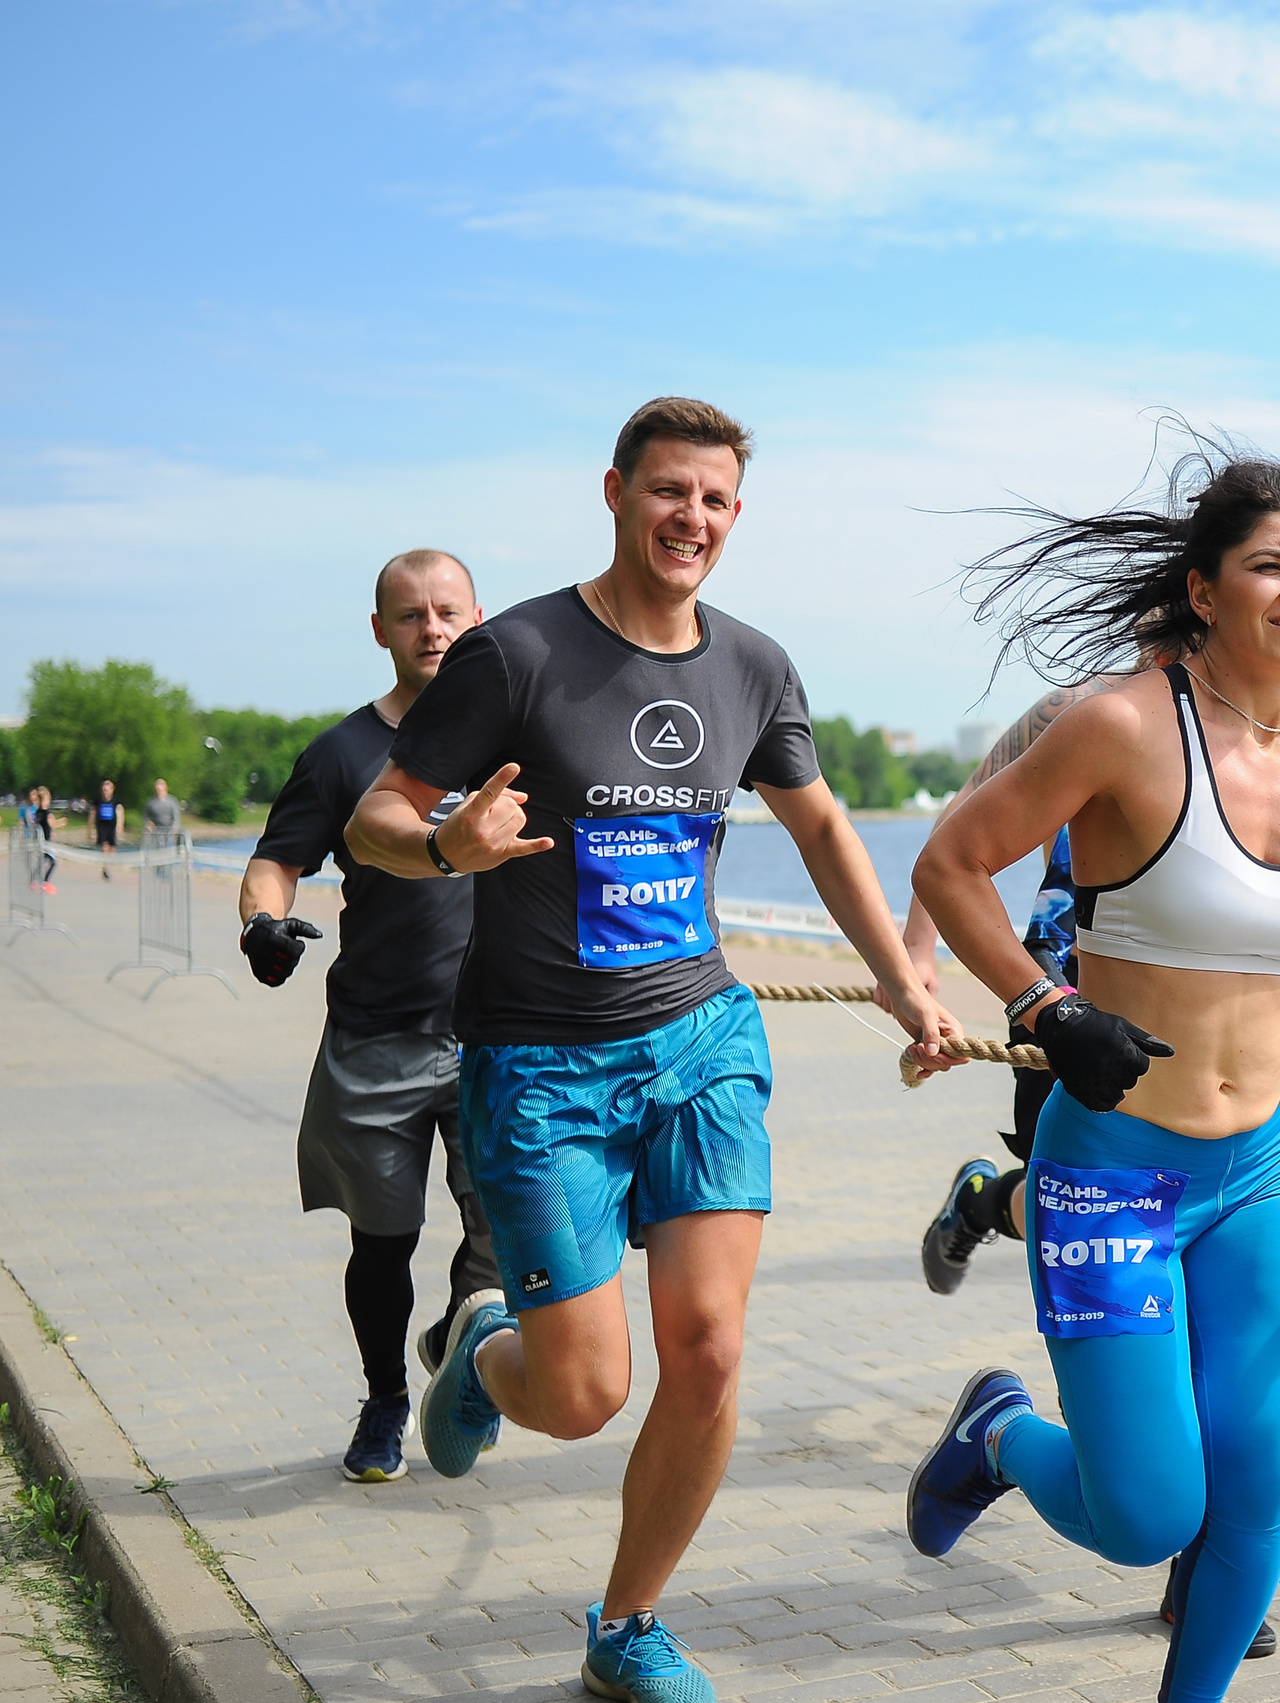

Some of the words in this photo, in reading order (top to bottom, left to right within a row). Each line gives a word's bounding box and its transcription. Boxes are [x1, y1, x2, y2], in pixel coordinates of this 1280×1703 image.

[586, 785, 729, 811] CROSSFIT
[587, 830, 658, 843] СТАНЬ
[588, 837, 700, 858] ЧЕЛОВЕКОМ
[1035, 979, 1055, 996] ТВОЯ
[1008, 993, 1036, 1018] СКИДКА
[1039, 1175, 1108, 1199] СТАНЬ
